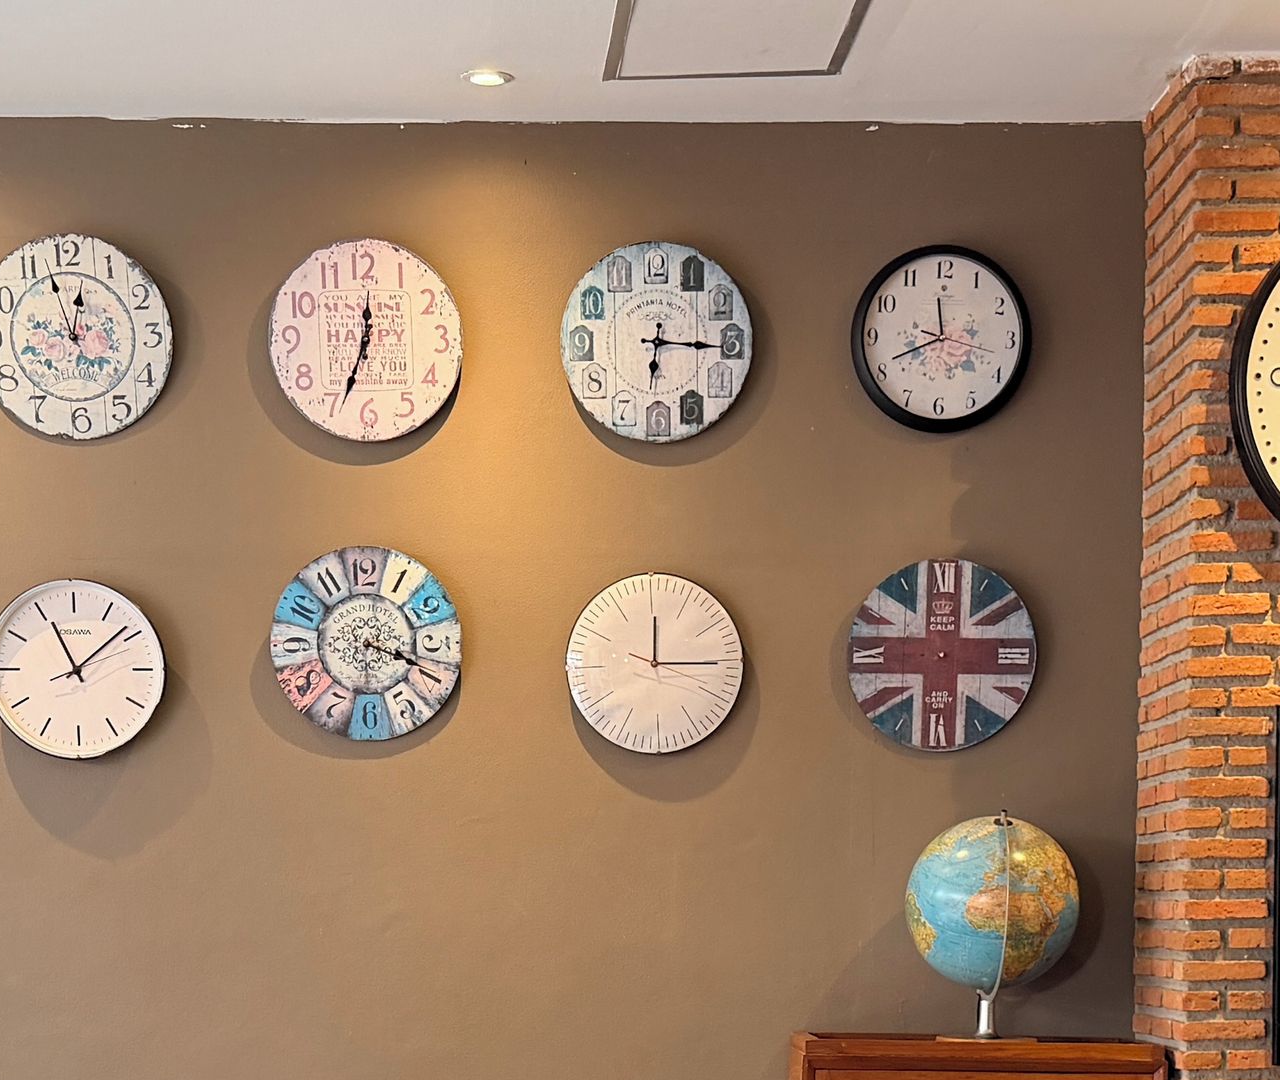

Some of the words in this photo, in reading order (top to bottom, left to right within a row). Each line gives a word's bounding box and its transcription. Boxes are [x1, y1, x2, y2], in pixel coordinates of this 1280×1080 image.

[54, 240, 80, 267] 12
[647, 254, 665, 277] 12
[20, 255, 38, 279] 11
[321, 262, 339, 289] 11
[351, 252, 375, 281] 12
[904, 269, 917, 287] 11
[936, 260, 953, 279] 12
[132, 284, 150, 310] 2
[292, 291, 316, 319] 10
[420, 288, 435, 315] 2
[584, 291, 602, 315] 10
[626, 299, 664, 318] PRINTANIA
[666, 300, 688, 318] HOTEL
[713, 293, 727, 316] 2
[877, 295, 896, 313] 10
[995, 297, 1005, 315] 2
[143, 323, 163, 348] 3
[281, 325, 301, 354] 9
[434, 324, 449, 353] 3
[574, 332, 590, 356] 9
[724, 331, 740, 355] 3
[867, 328, 878, 346] 9
[1005, 331, 1015, 349] 3
[52, 367, 100, 382] WELCOME
[137, 362, 156, 387] 4
[295, 364, 313, 391] 8
[340, 361, 374, 372] LOVE
[380, 361, 406, 372] YOU
[421, 362, 438, 387] 4
[877, 363, 887, 382] 8
[992, 366, 1001, 383] 4
[587, 370, 602, 393] 8
[28, 395, 47, 423] 7
[112, 395, 131, 421] 5
[324, 392, 340, 417] 7
[398, 392, 415, 418] 5
[617, 400, 631, 421] 7
[903, 389, 912, 408] 7
[933, 397, 944, 415] 6
[966, 391, 976, 409] 5
[72, 407, 92, 433] 6
[360, 398, 378, 427] 6
[651, 408, 666, 431] 6
[317, 567, 342, 597] 11
[352, 558, 376, 587] 12
[391, 569, 408, 593] 1
[933, 563, 956, 594] XII
[291, 594, 320, 623] 10
[333, 604, 365, 624] GRAND
[368, 604, 399, 624] HOTEL
[282, 636, 311, 654] 9
[853, 646, 885, 664] IX
[998, 648, 1030, 665] III
[295, 669, 321, 697] 8
[326, 692, 347, 719] 7
[362, 701, 377, 729] 6
[393, 691, 415, 720] 5
[929, 713, 947, 747] VI
